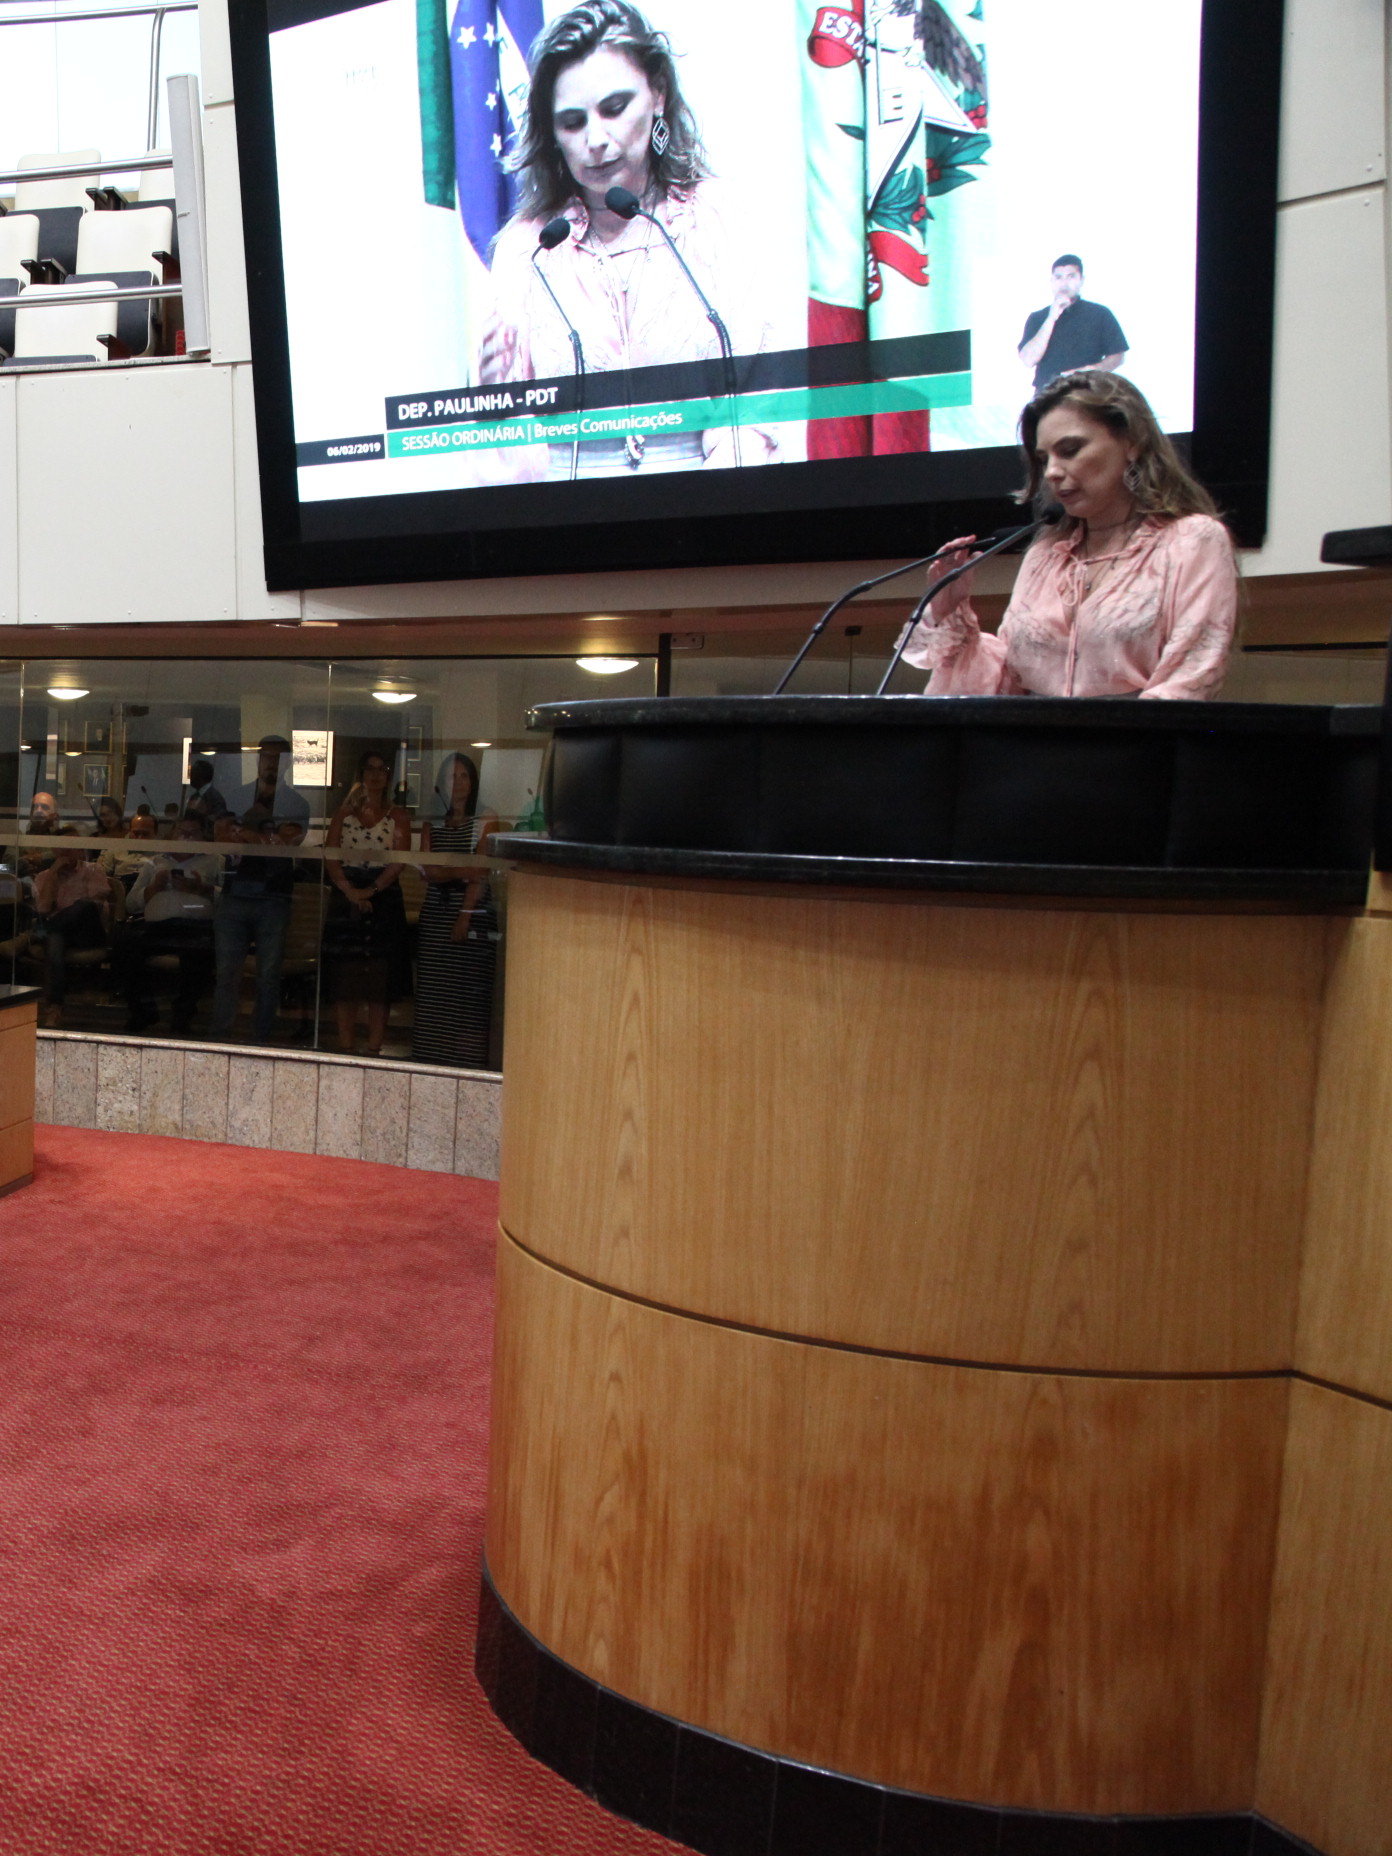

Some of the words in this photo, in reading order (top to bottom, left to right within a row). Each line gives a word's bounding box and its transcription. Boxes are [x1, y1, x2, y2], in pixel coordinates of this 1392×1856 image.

[398, 402, 432, 421] DEP.
[434, 393, 514, 416] PAULINHA
[526, 388, 558, 406] PDT
[402, 432, 450, 451] SESSÃO
[452, 425, 525, 446] ORDINÁRIA
[534, 422, 578, 438] Breves
[580, 411, 683, 434] Comunicações
[327, 442, 381, 457] 06/02/2019
